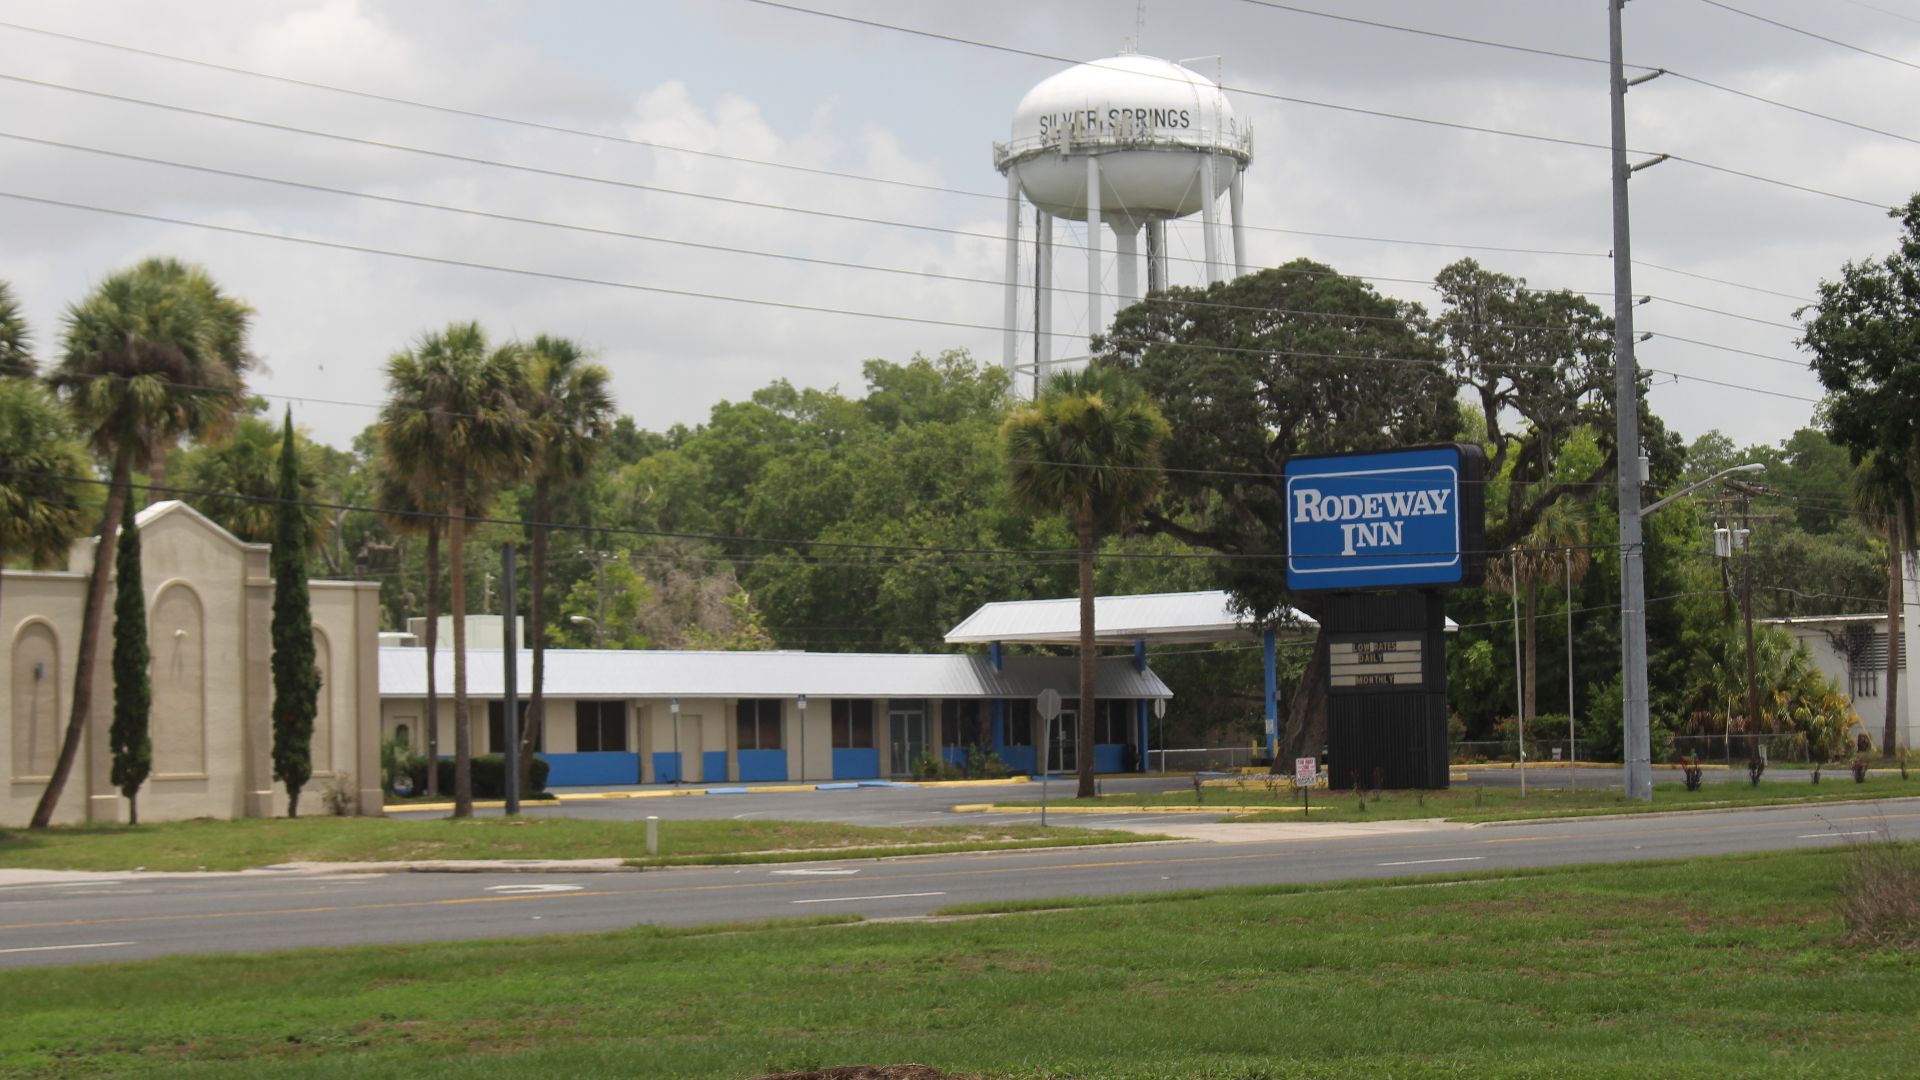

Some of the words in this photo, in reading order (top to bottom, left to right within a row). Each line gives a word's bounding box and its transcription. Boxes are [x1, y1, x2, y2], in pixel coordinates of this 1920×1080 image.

[1294, 489, 1450, 523] RODEWAY
[1341, 521, 1404, 556] INN
[1353, 643, 1370, 652] LOW
[1373, 642, 1396, 651] RATES
[1359, 653, 1383, 663] DAILY
